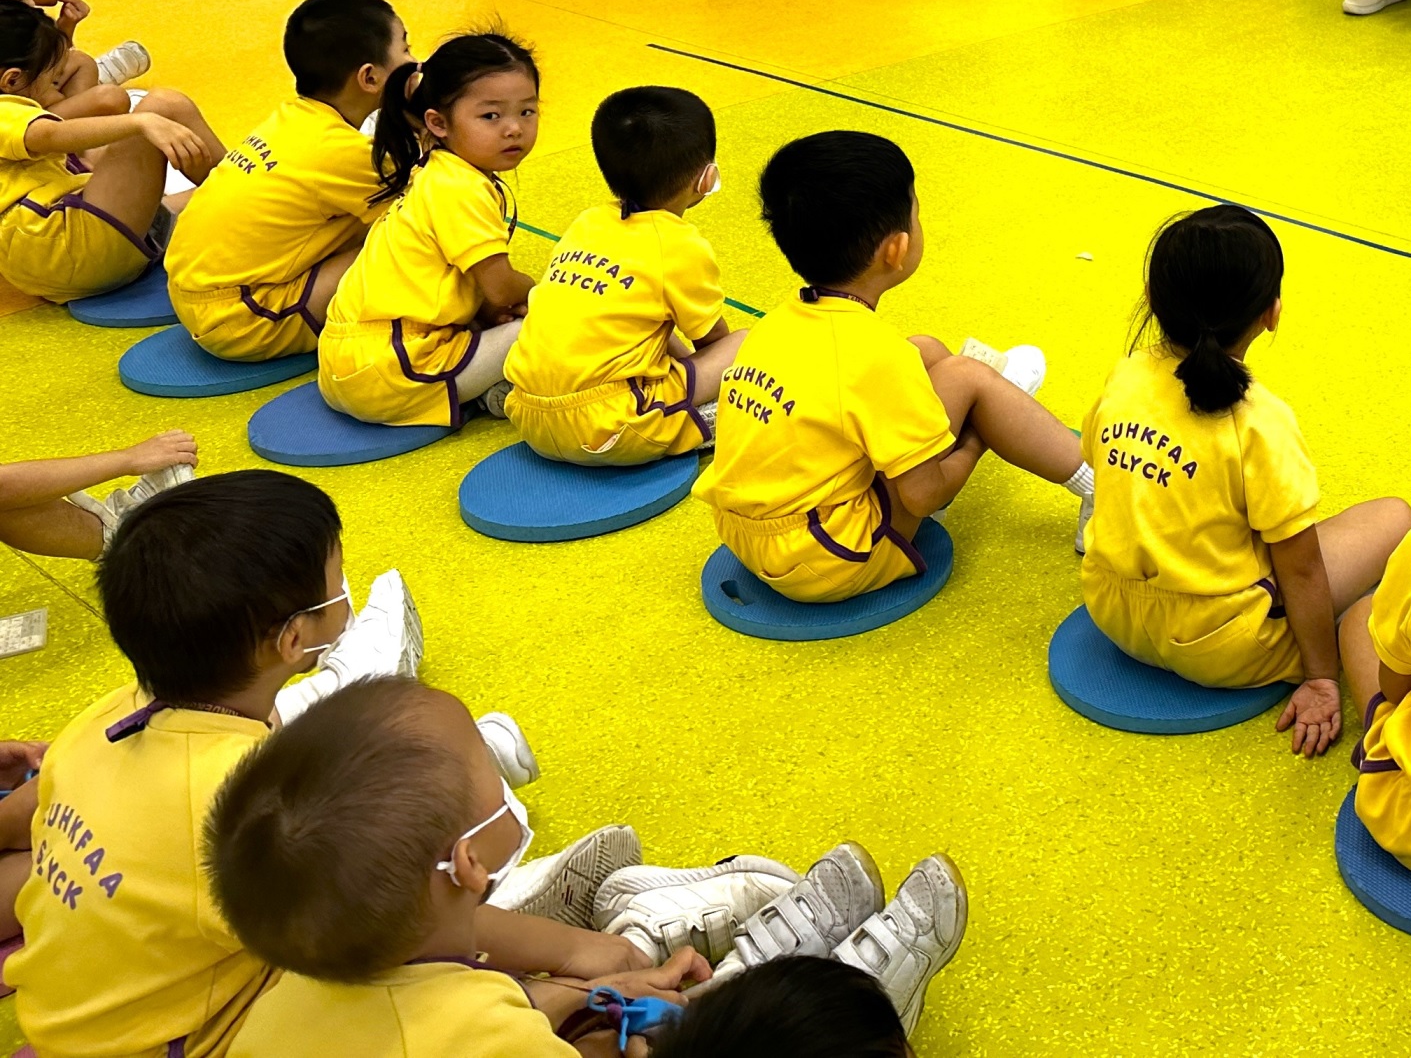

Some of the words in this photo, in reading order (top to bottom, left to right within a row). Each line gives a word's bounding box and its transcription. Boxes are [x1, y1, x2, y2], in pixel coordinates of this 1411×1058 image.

[549, 269, 609, 295] SLYCK
[550, 251, 635, 290] CUHKFAA
[723, 366, 796, 417] CUHKFAA
[728, 388, 773, 425] SLYCK
[1101, 422, 1198, 480] CUHKFAA
[1107, 448, 1172, 488] SLYCK
[43, 803, 123, 899] UHKFAA
